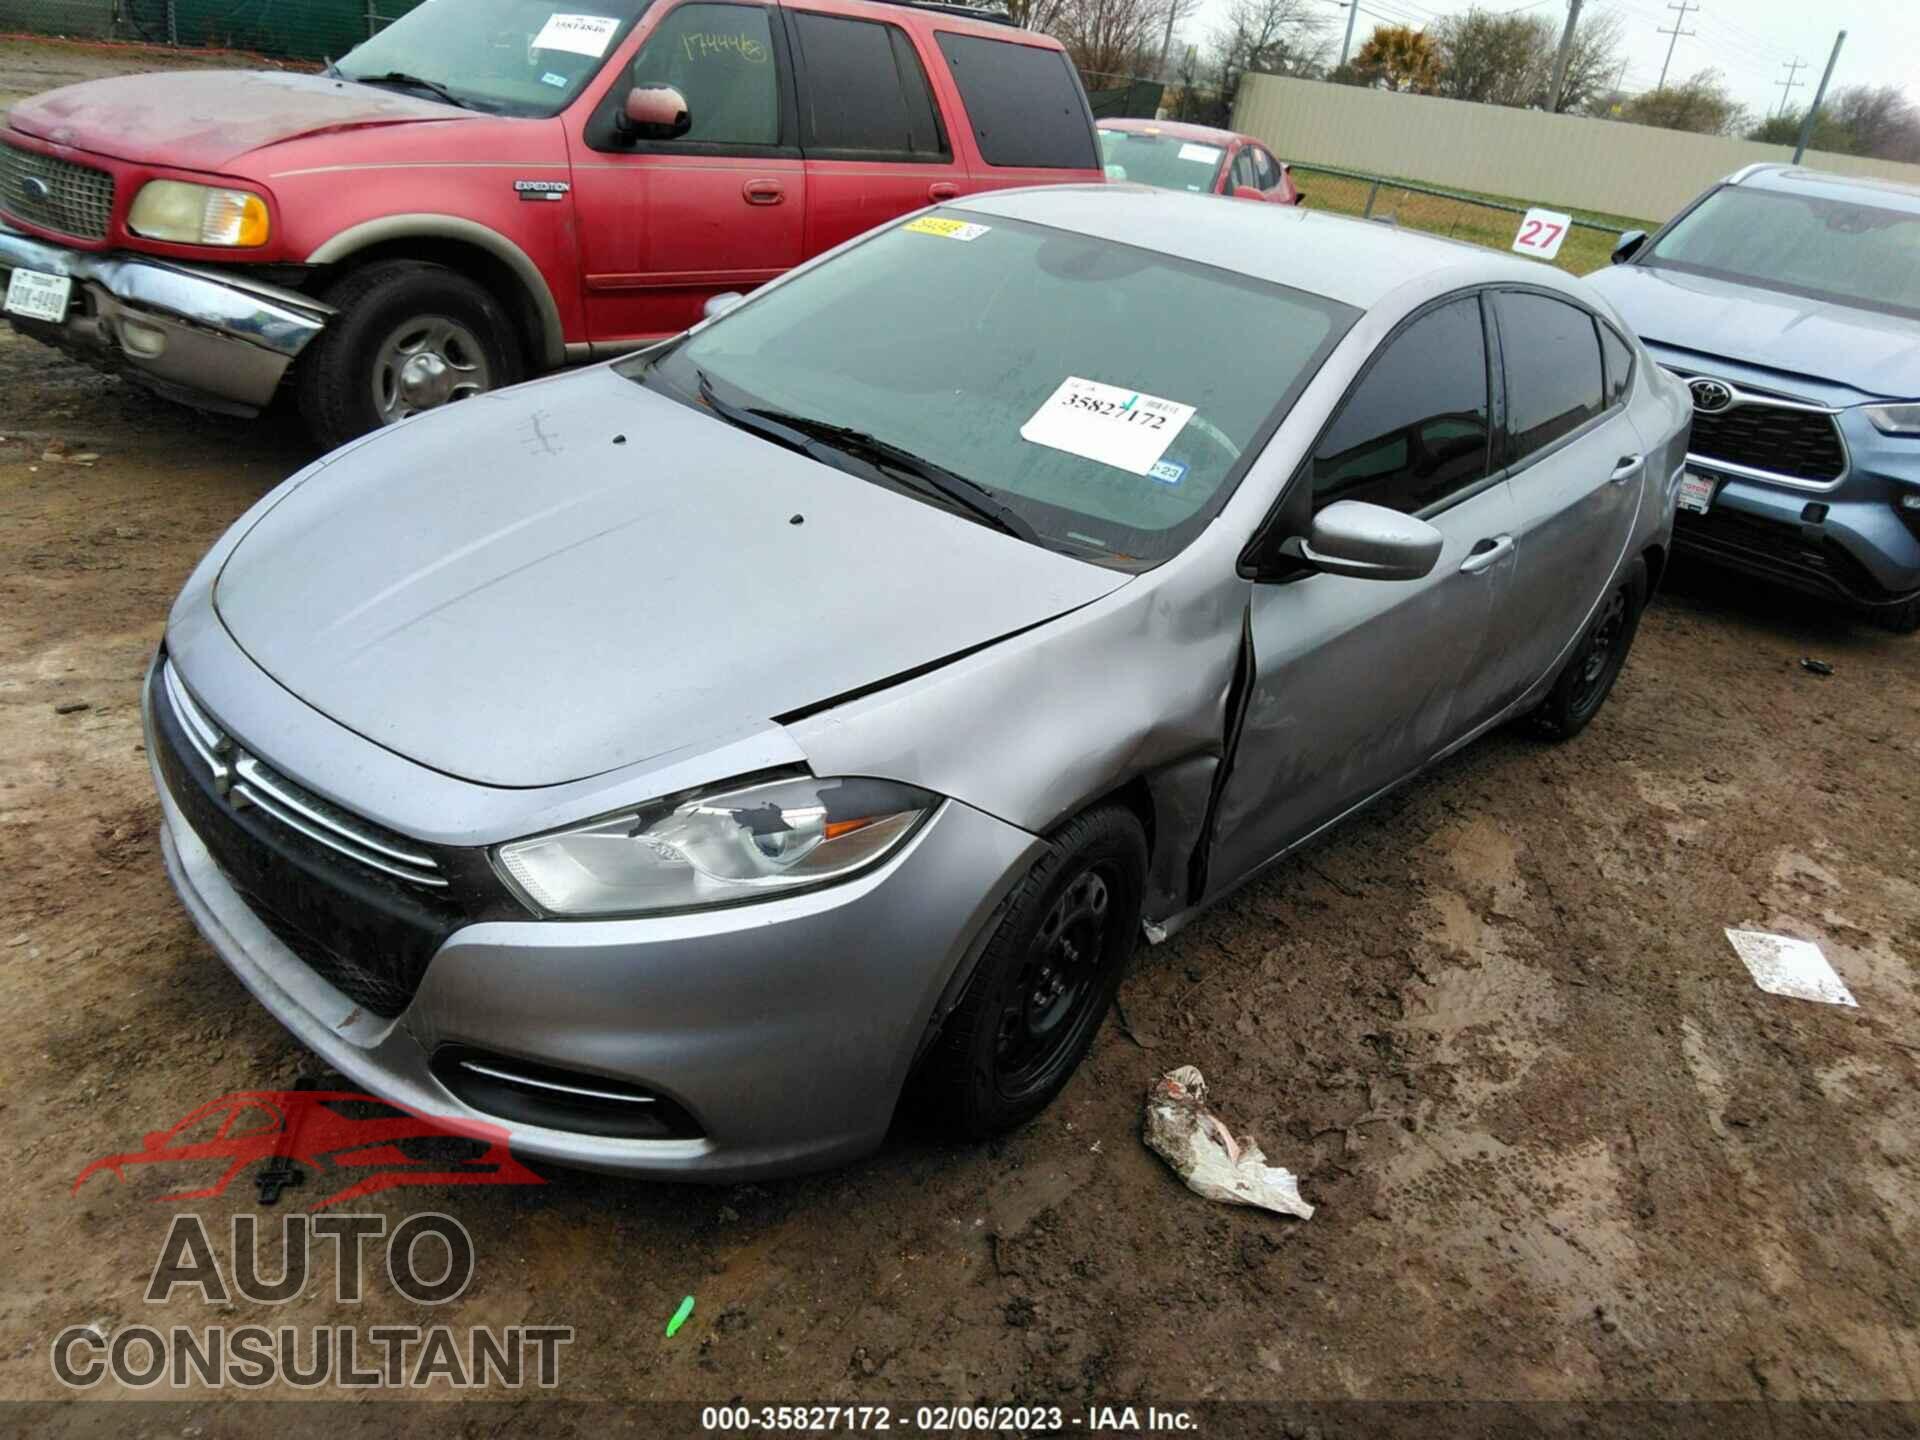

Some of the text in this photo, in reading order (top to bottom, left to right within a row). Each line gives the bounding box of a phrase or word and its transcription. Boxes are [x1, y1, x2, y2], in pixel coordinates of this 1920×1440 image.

[514, 181, 569, 192] EXPEDITION
[1518, 220, 1563, 249] 27
[1061, 393, 1167, 430] 35827172
